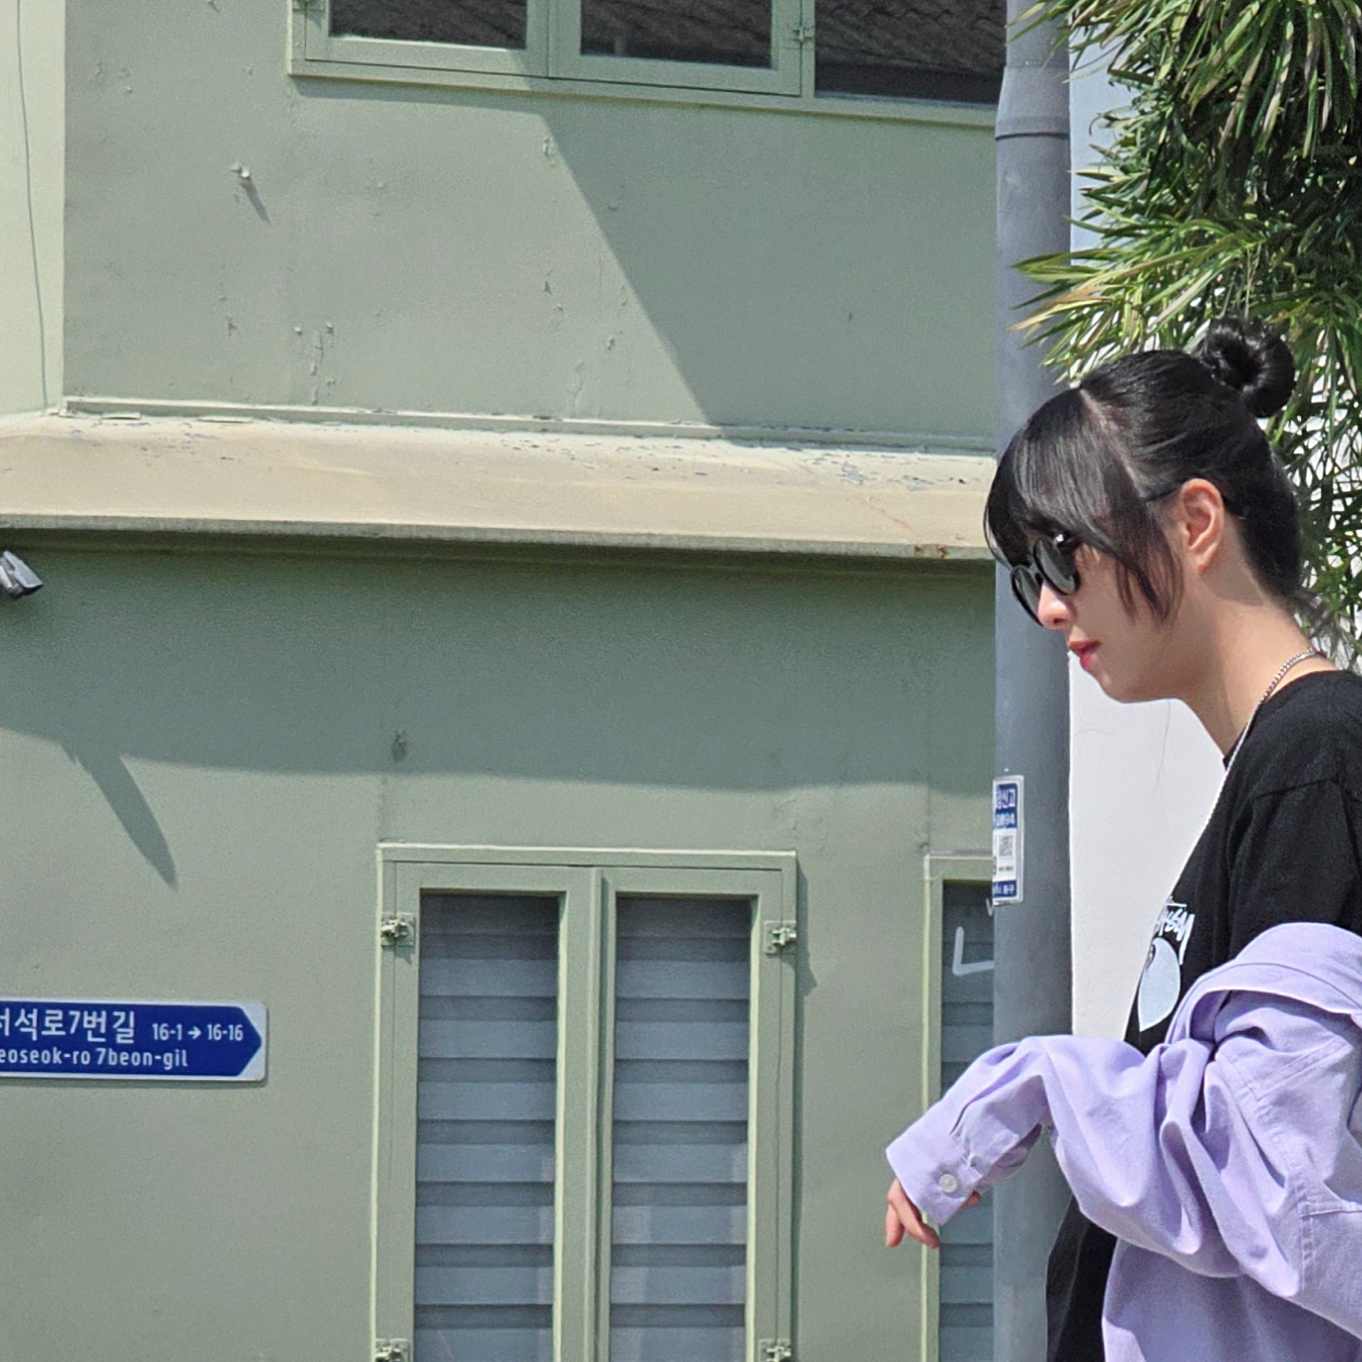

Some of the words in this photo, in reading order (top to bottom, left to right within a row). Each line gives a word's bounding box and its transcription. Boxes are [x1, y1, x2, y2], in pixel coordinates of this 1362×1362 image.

[152, 1022, 183, 1041] 16-1
[207, 1023, 244, 1042] 16-16
[96, 1048, 188, 1071] 7beon-gil
